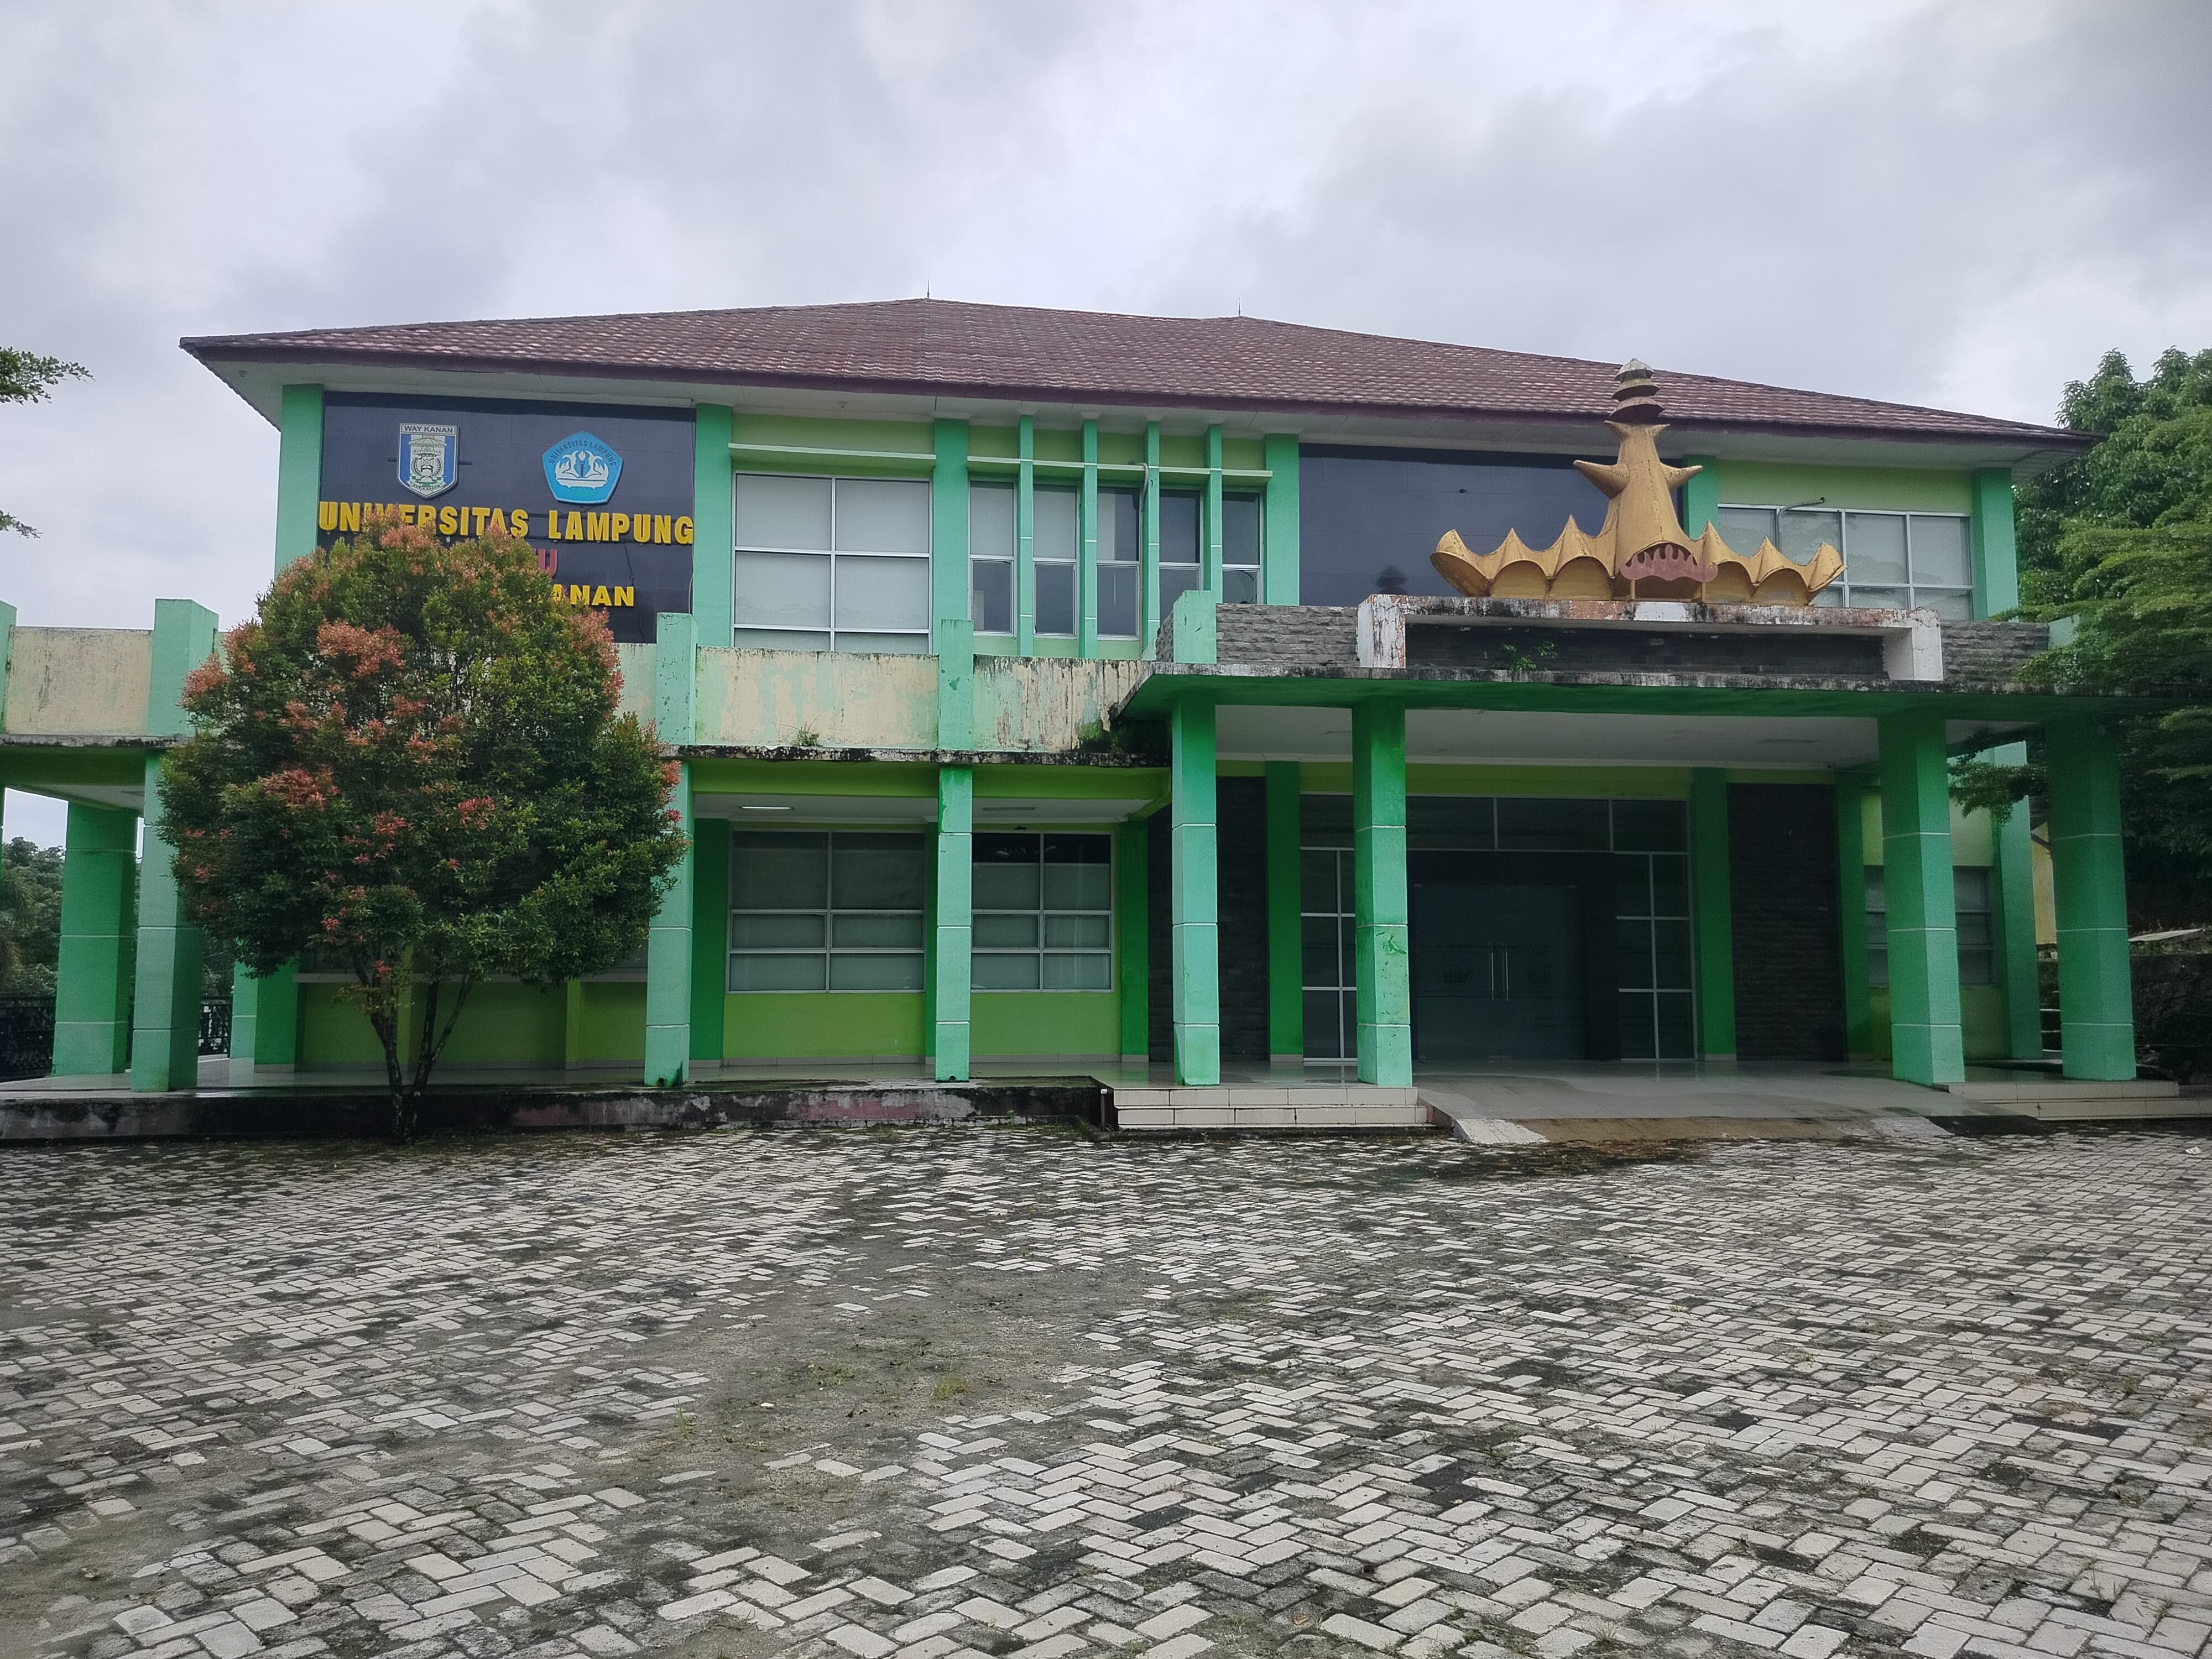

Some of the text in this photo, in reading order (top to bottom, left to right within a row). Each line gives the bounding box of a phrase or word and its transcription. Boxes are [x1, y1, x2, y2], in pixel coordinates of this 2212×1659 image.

[548, 440, 617, 467] UNIVERSITAS LAMPUNG
[549, 510, 693, 544] LAMPUNG
[526, 584, 634, 606] ANAN
